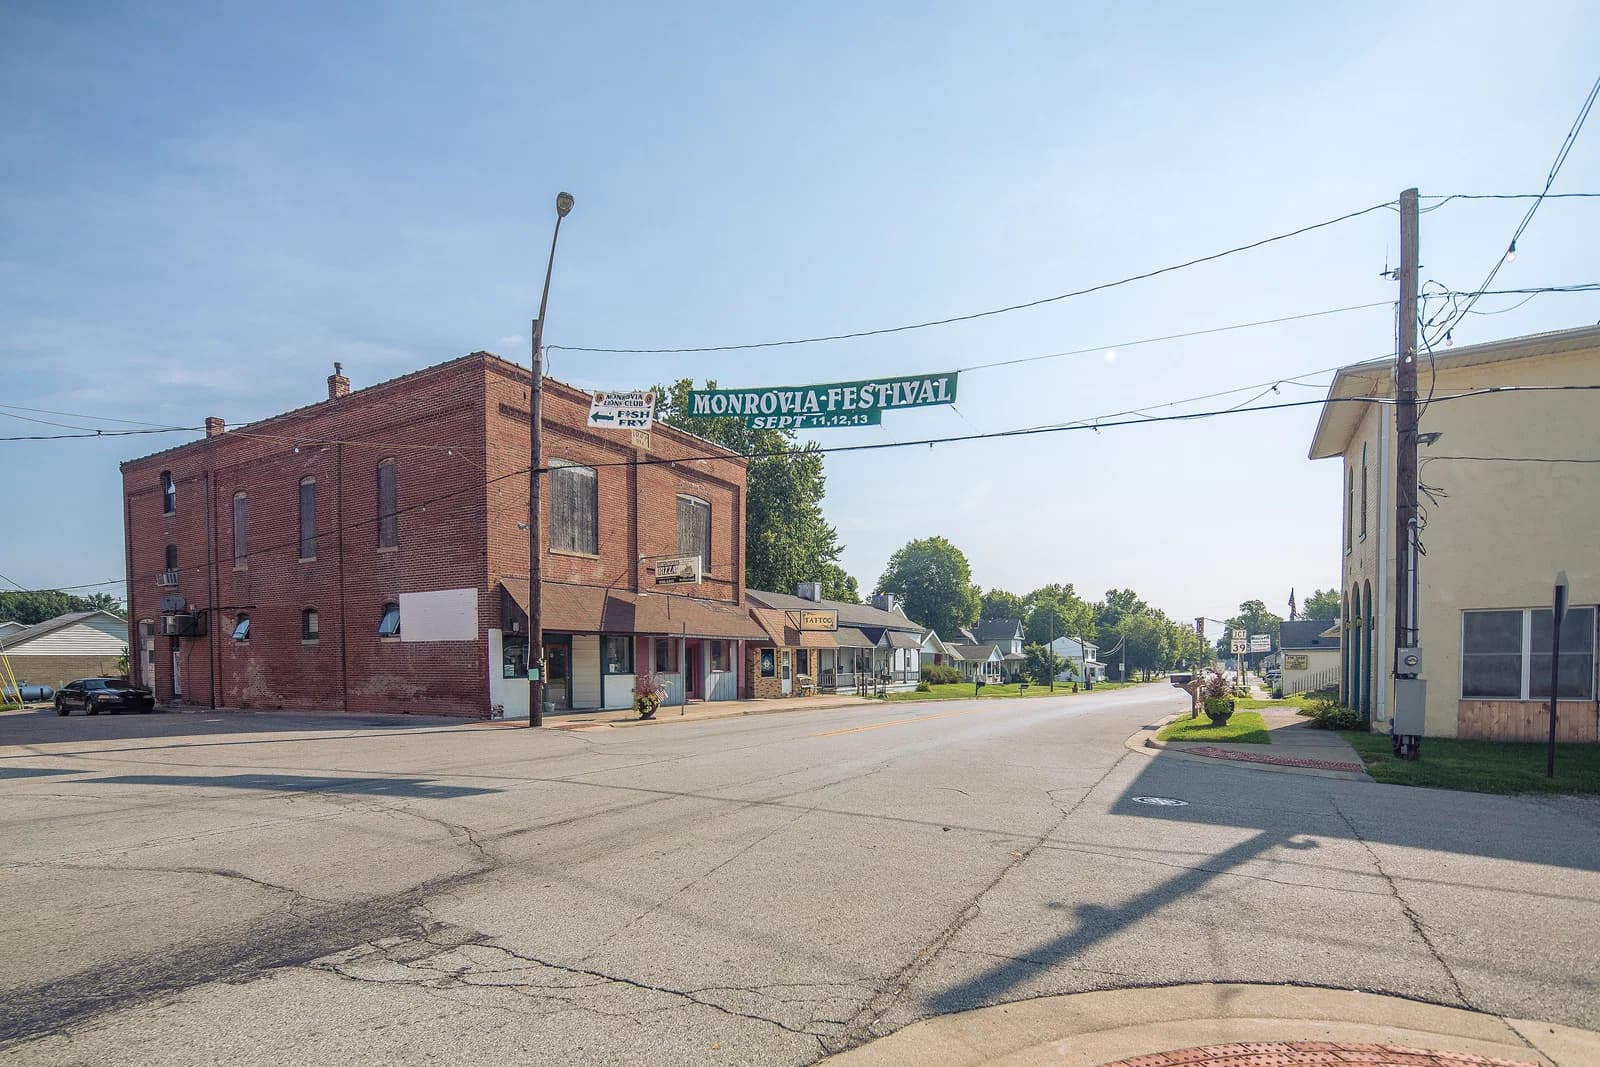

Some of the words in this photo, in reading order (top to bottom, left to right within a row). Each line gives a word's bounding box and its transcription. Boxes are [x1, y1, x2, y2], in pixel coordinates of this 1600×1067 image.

[605, 393, 643, 401] MONROVIA
[692, 389, 820, 414] MONROVIA
[827, 378, 951, 410] FESTIVAL
[617, 410, 650, 418] FISH
[751, 415, 807, 429] SEPT
[811, 414, 868, 426] 11,12,13
[1233, 630, 1245, 638] JCT
[1232, 644, 1246, 652] 39
